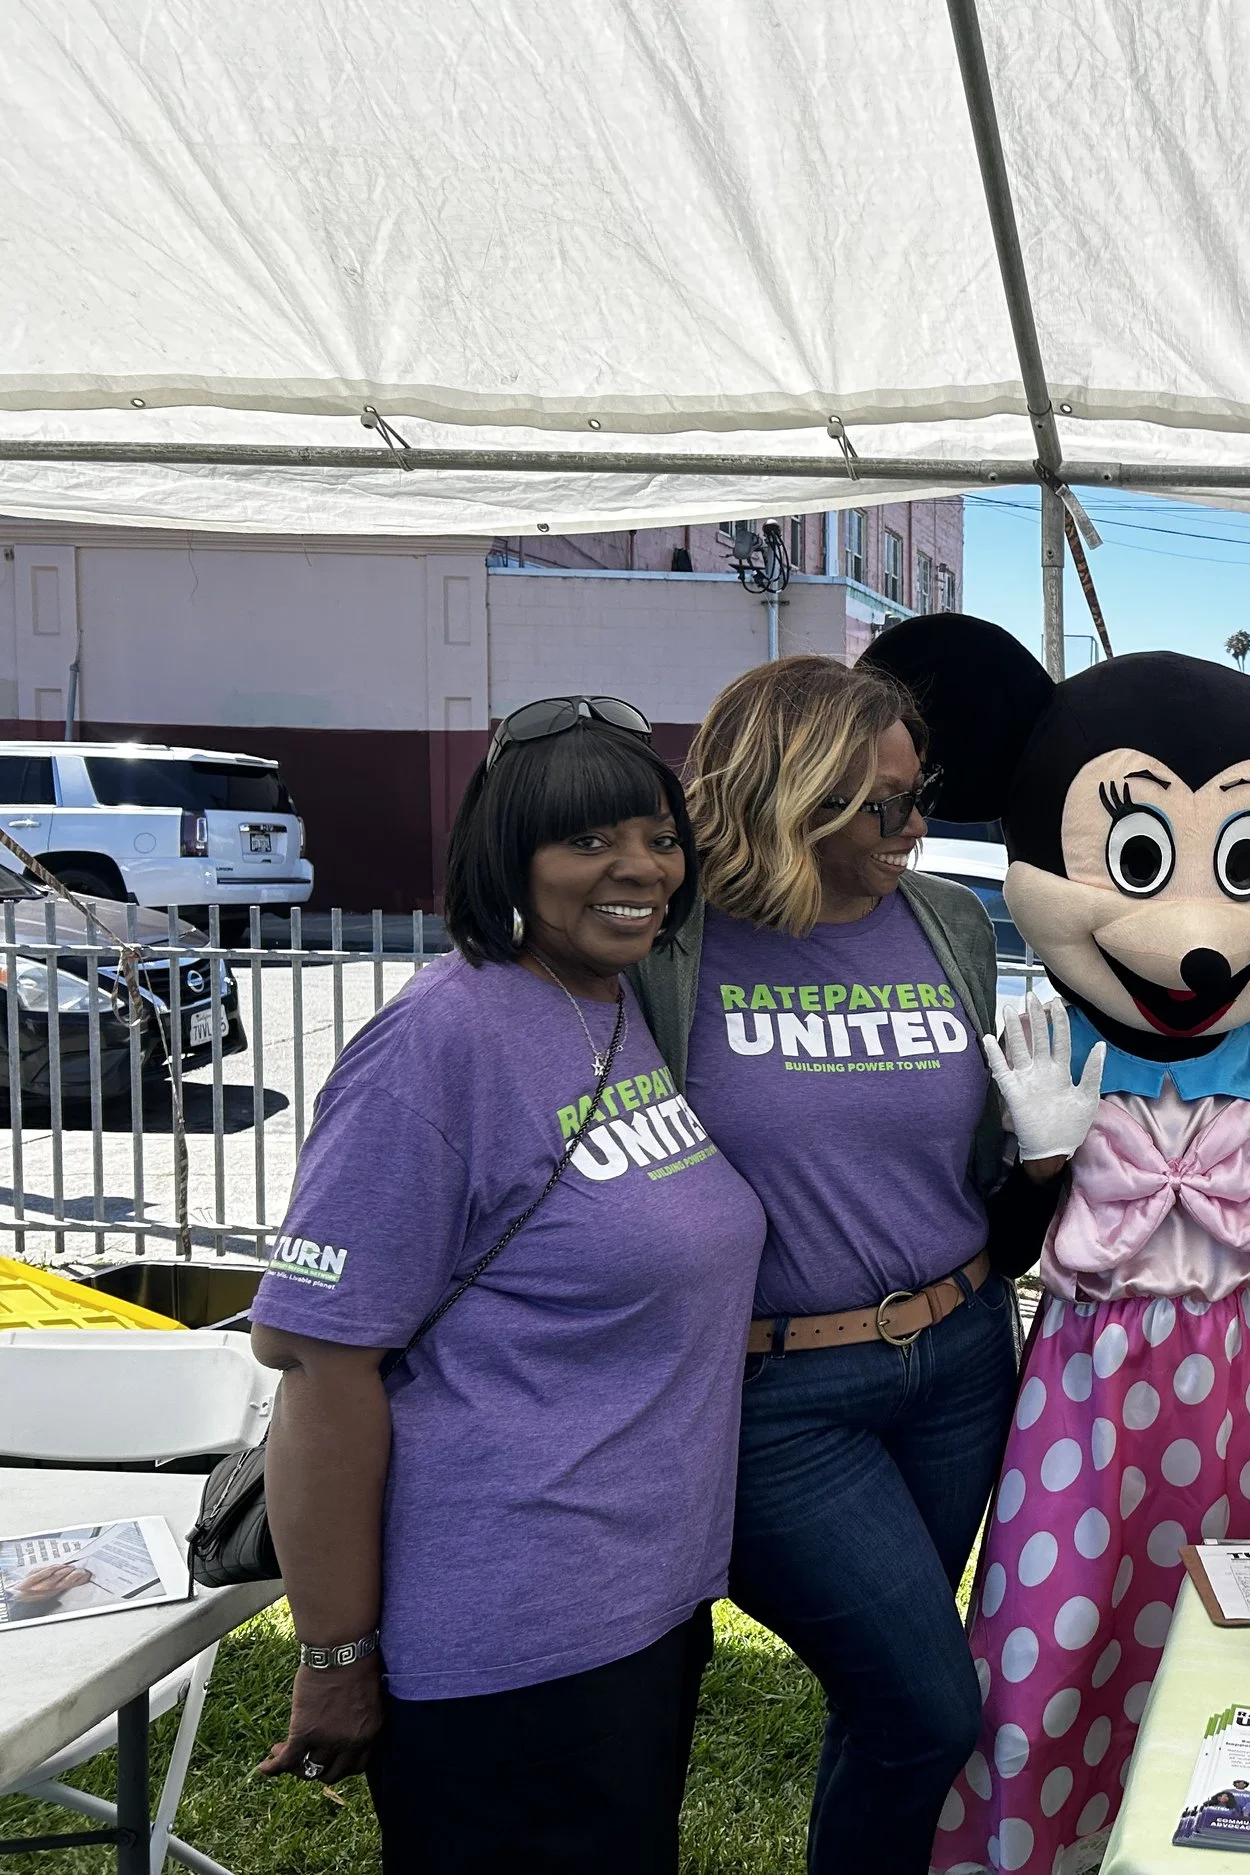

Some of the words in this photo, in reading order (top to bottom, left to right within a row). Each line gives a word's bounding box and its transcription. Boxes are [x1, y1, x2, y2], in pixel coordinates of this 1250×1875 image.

[720, 983, 956, 1011] RATEPAYERS
[725, 1010, 968, 1058] UNITED
[785, 1060, 845, 1073] BUILDING
[848, 1061, 894, 1072] POWER
[896, 1060, 914, 1071] TO
[915, 1060, 941, 1070] WIN
[556, 1065, 675, 1139] RATEPAY
[647, 1160, 685, 1181] BUILDING
[289, 1273, 312, 1285] Livable
[312, 1279, 337, 1291] planet.
